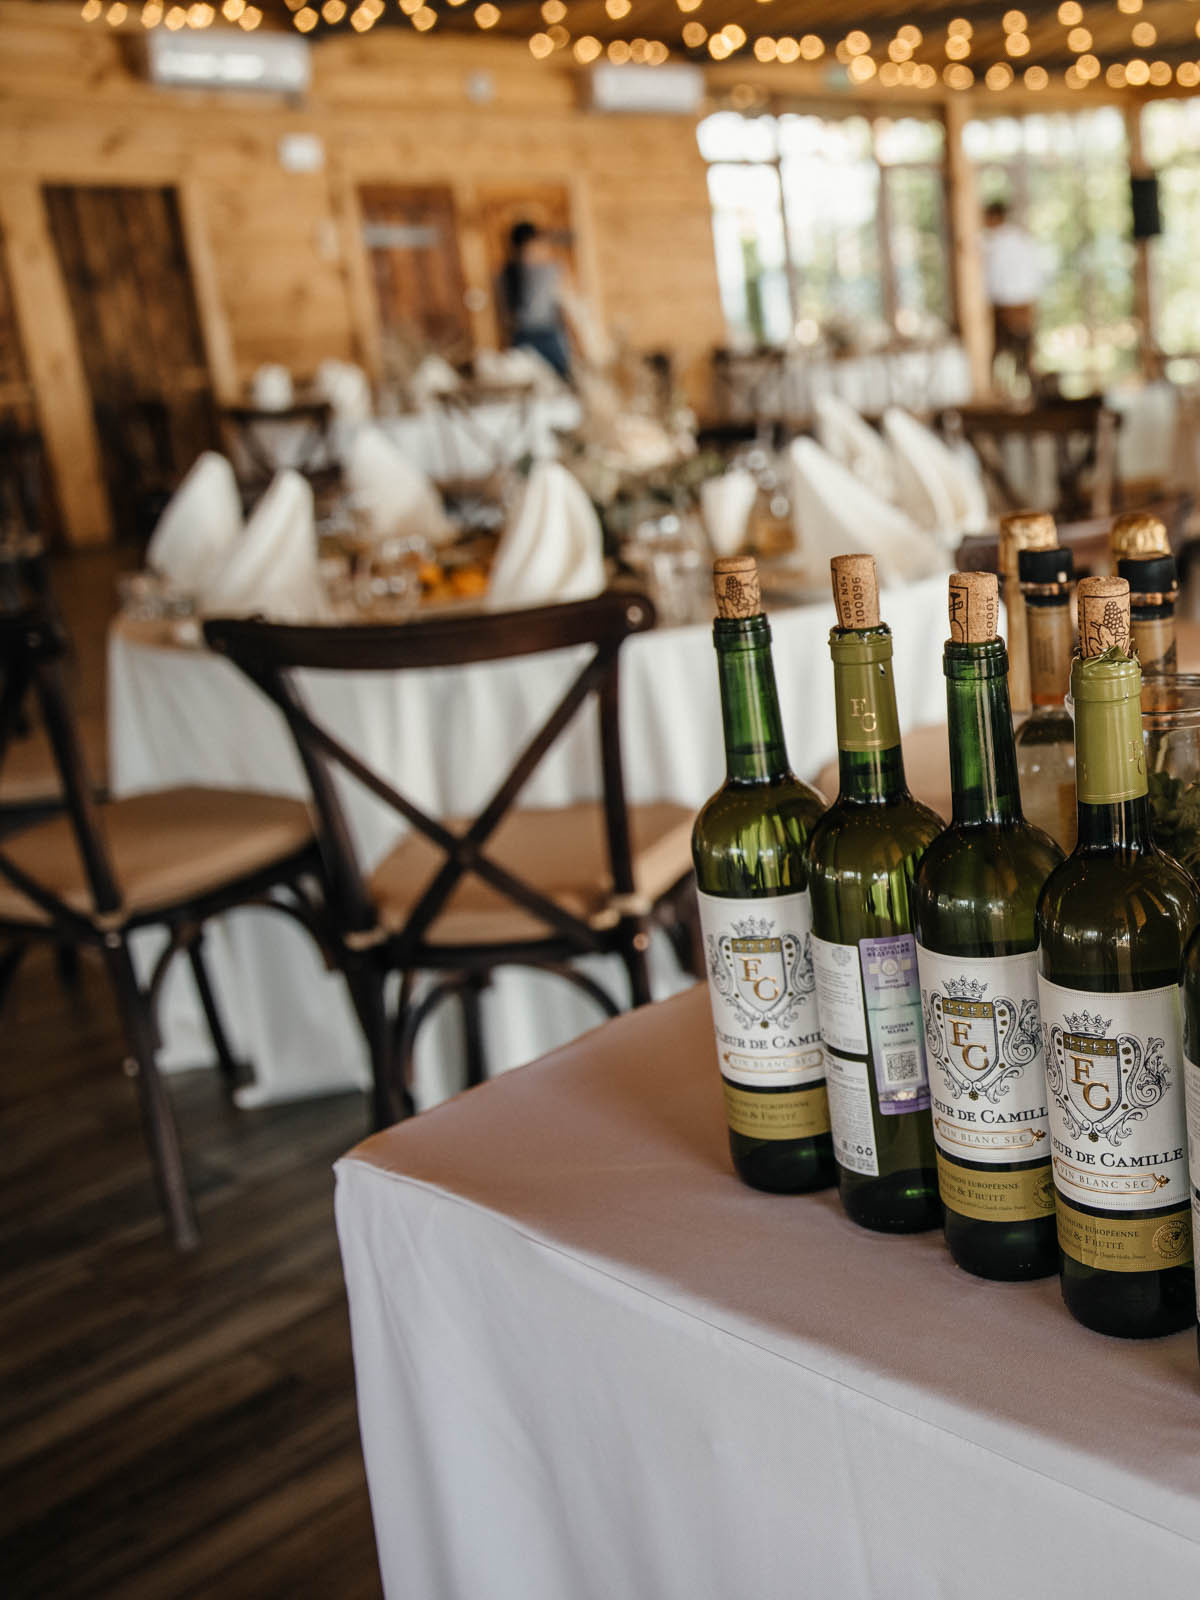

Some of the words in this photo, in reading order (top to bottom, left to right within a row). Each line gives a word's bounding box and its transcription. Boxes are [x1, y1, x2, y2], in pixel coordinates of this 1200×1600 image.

[852, 577, 865, 623] 100096
[749, 1039, 768, 1049] DE
[957, 1109, 977, 1122] DE
[960, 1134, 999, 1145] BLANC
[1004, 1134, 1026, 1144] SEC
[1075, 1150, 1096, 1165] DE
[1100, 1147, 1184, 1168] CAMILLE
[1059, 1166, 1075, 1179] VIN
[1079, 1175, 1119, 1189] BLANC
[1123, 1180, 1149, 1189] SEC
